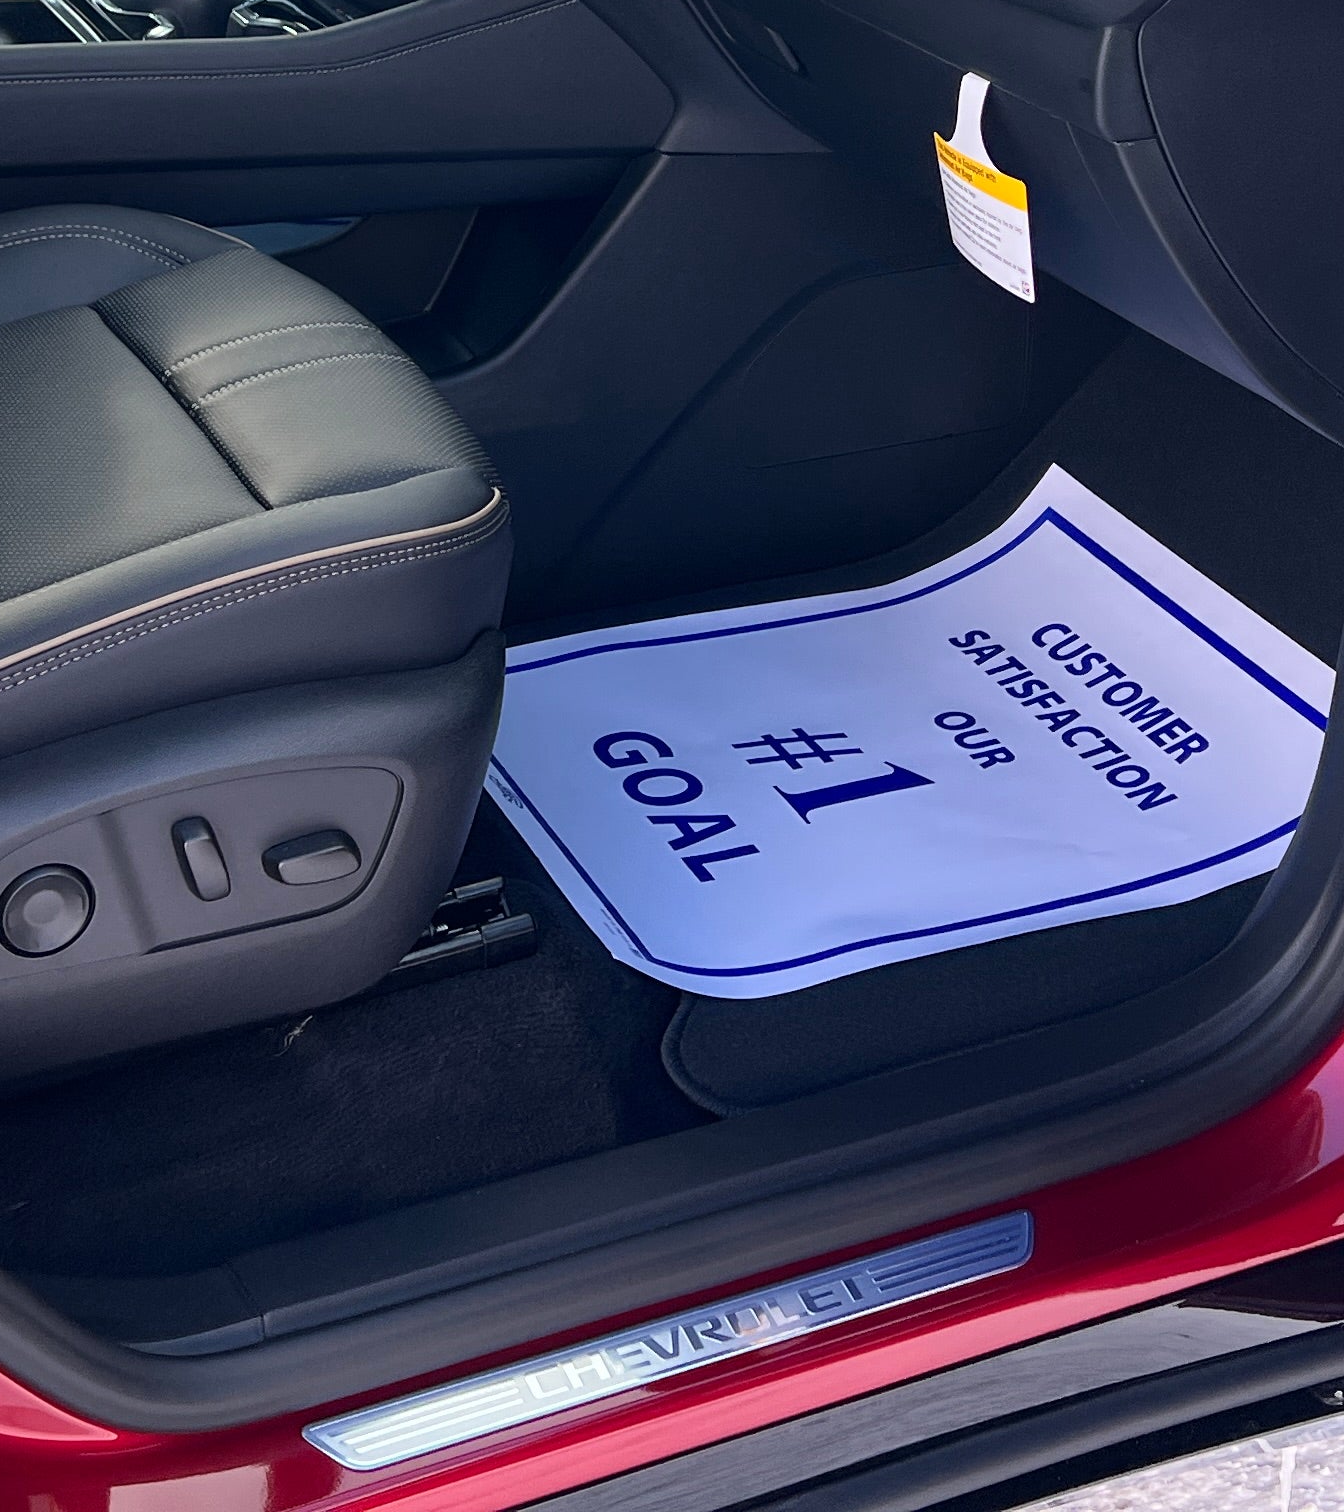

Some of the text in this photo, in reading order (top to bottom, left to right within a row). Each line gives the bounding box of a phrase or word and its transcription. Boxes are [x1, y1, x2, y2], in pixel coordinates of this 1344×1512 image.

[933, 711, 1016, 769] OUR
[948, 629, 1178, 811] SATISFACTION
[1031, 623, 1210, 764] CUSTOMER
[592, 731, 760, 883] GOAL
[731, 727, 936, 825] #1
[523, 1275, 867, 1401] CHEVROLET
